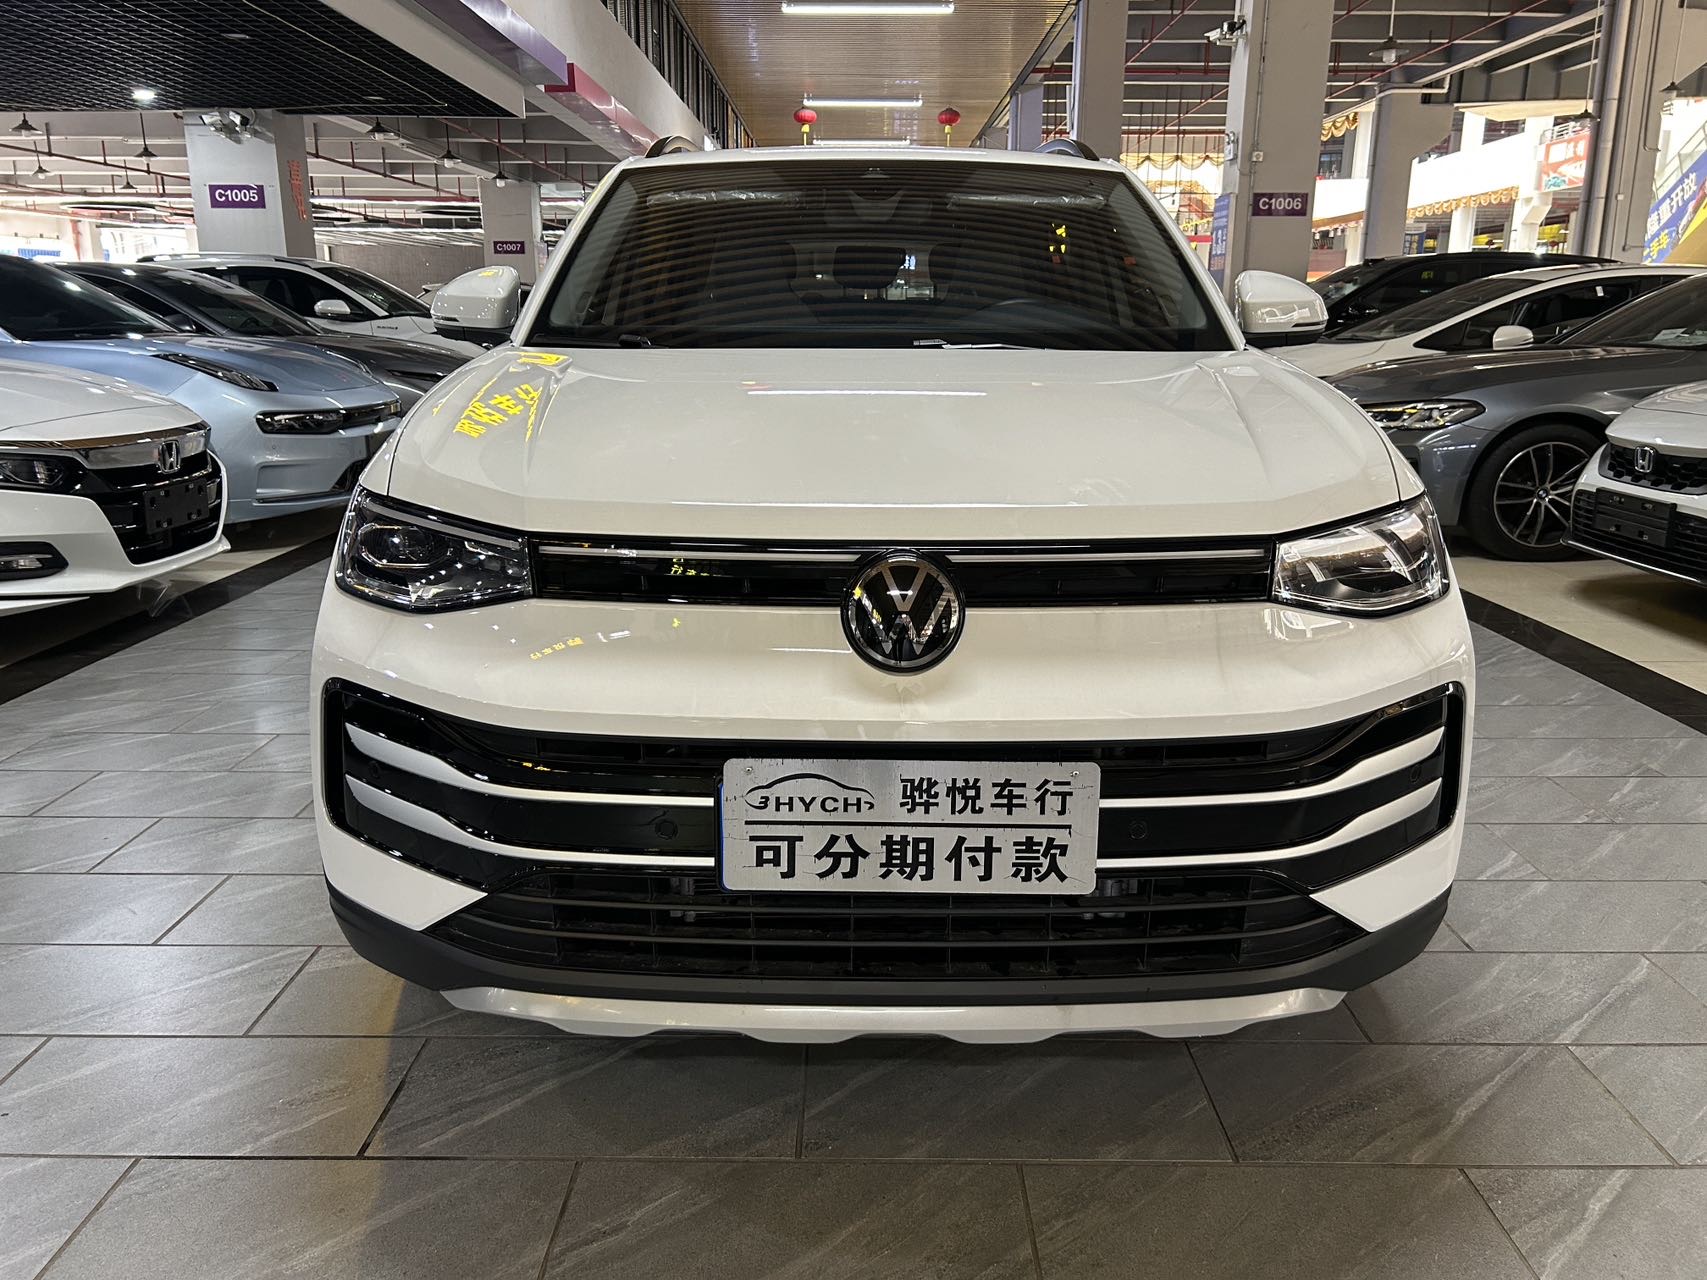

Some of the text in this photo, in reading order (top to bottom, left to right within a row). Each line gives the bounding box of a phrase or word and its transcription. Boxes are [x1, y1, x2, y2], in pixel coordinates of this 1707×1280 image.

[215, 189, 258, 202] C1005
[1258, 198, 1302, 210] C1006
[496, 243, 521, 251] C1007
[899, 776, 1074, 816] 骅悦车行
[748, 833, 1070, 884] 可分期付款
